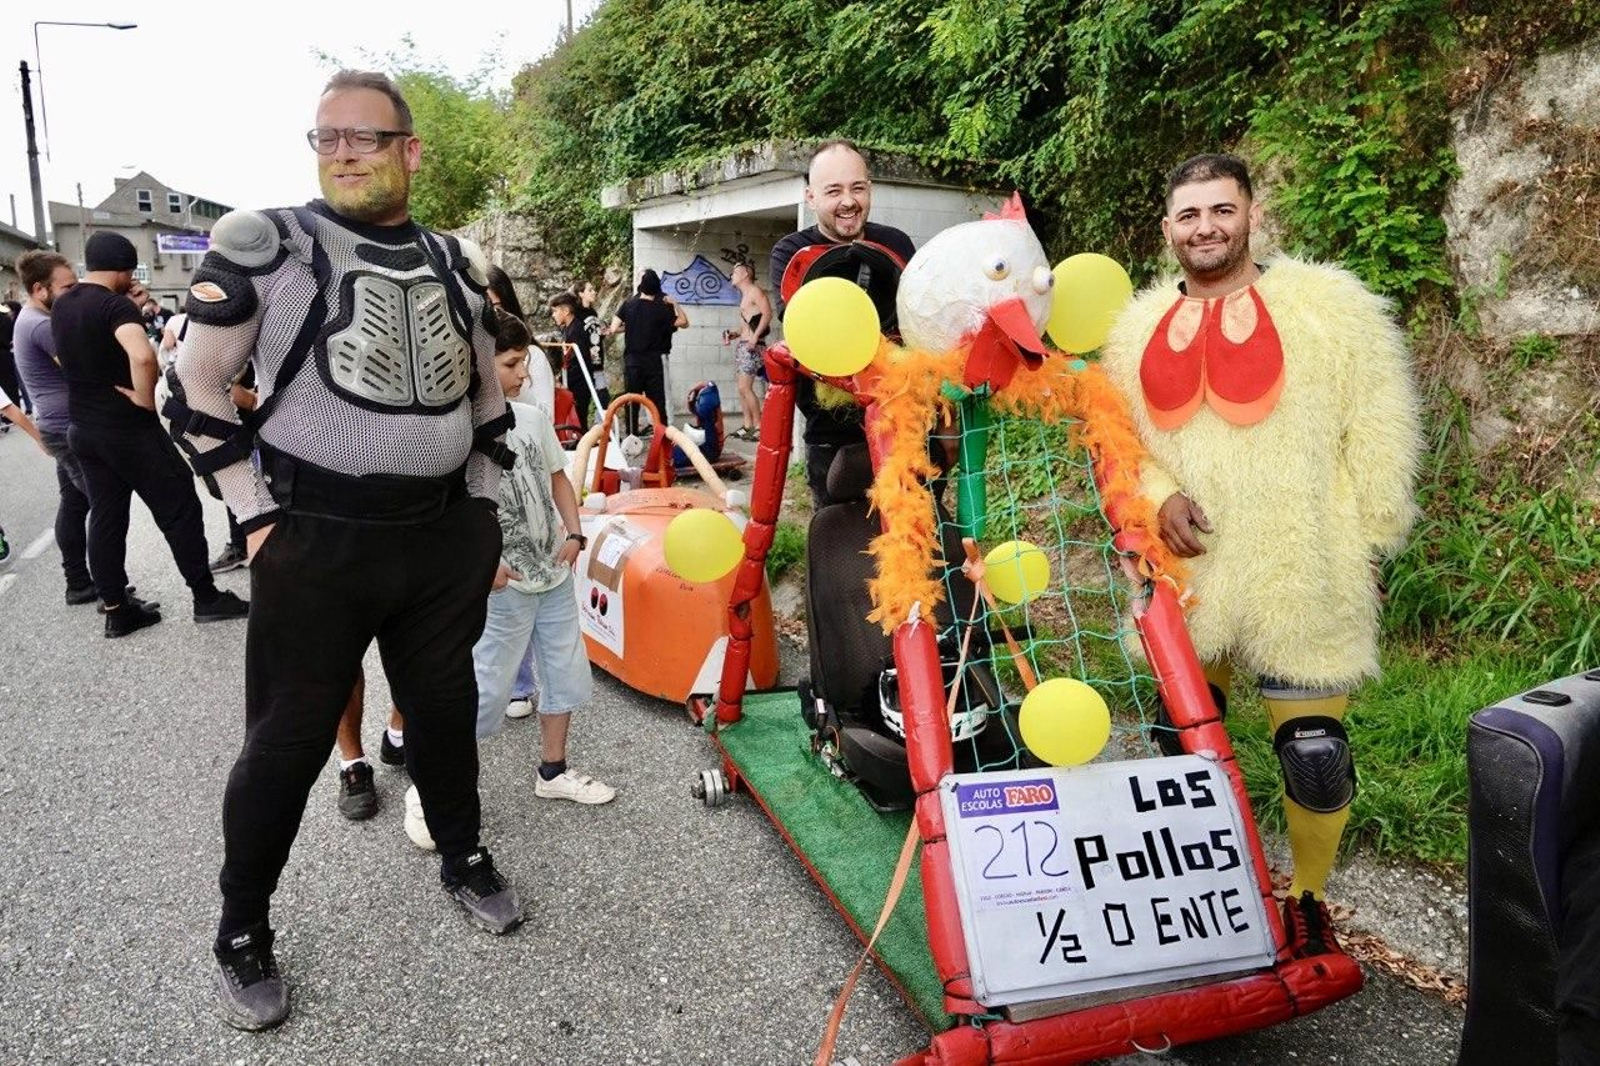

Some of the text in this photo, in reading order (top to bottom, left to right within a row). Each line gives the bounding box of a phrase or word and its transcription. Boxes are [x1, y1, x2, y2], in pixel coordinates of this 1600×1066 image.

[973, 788, 1000, 800] AUTO
[1004, 785, 1053, 807] FARO
[962, 799, 1003, 812] ESCOLAS
[975, 821, 1069, 879] 212
[1151, 888, 1250, 946] ENTE
